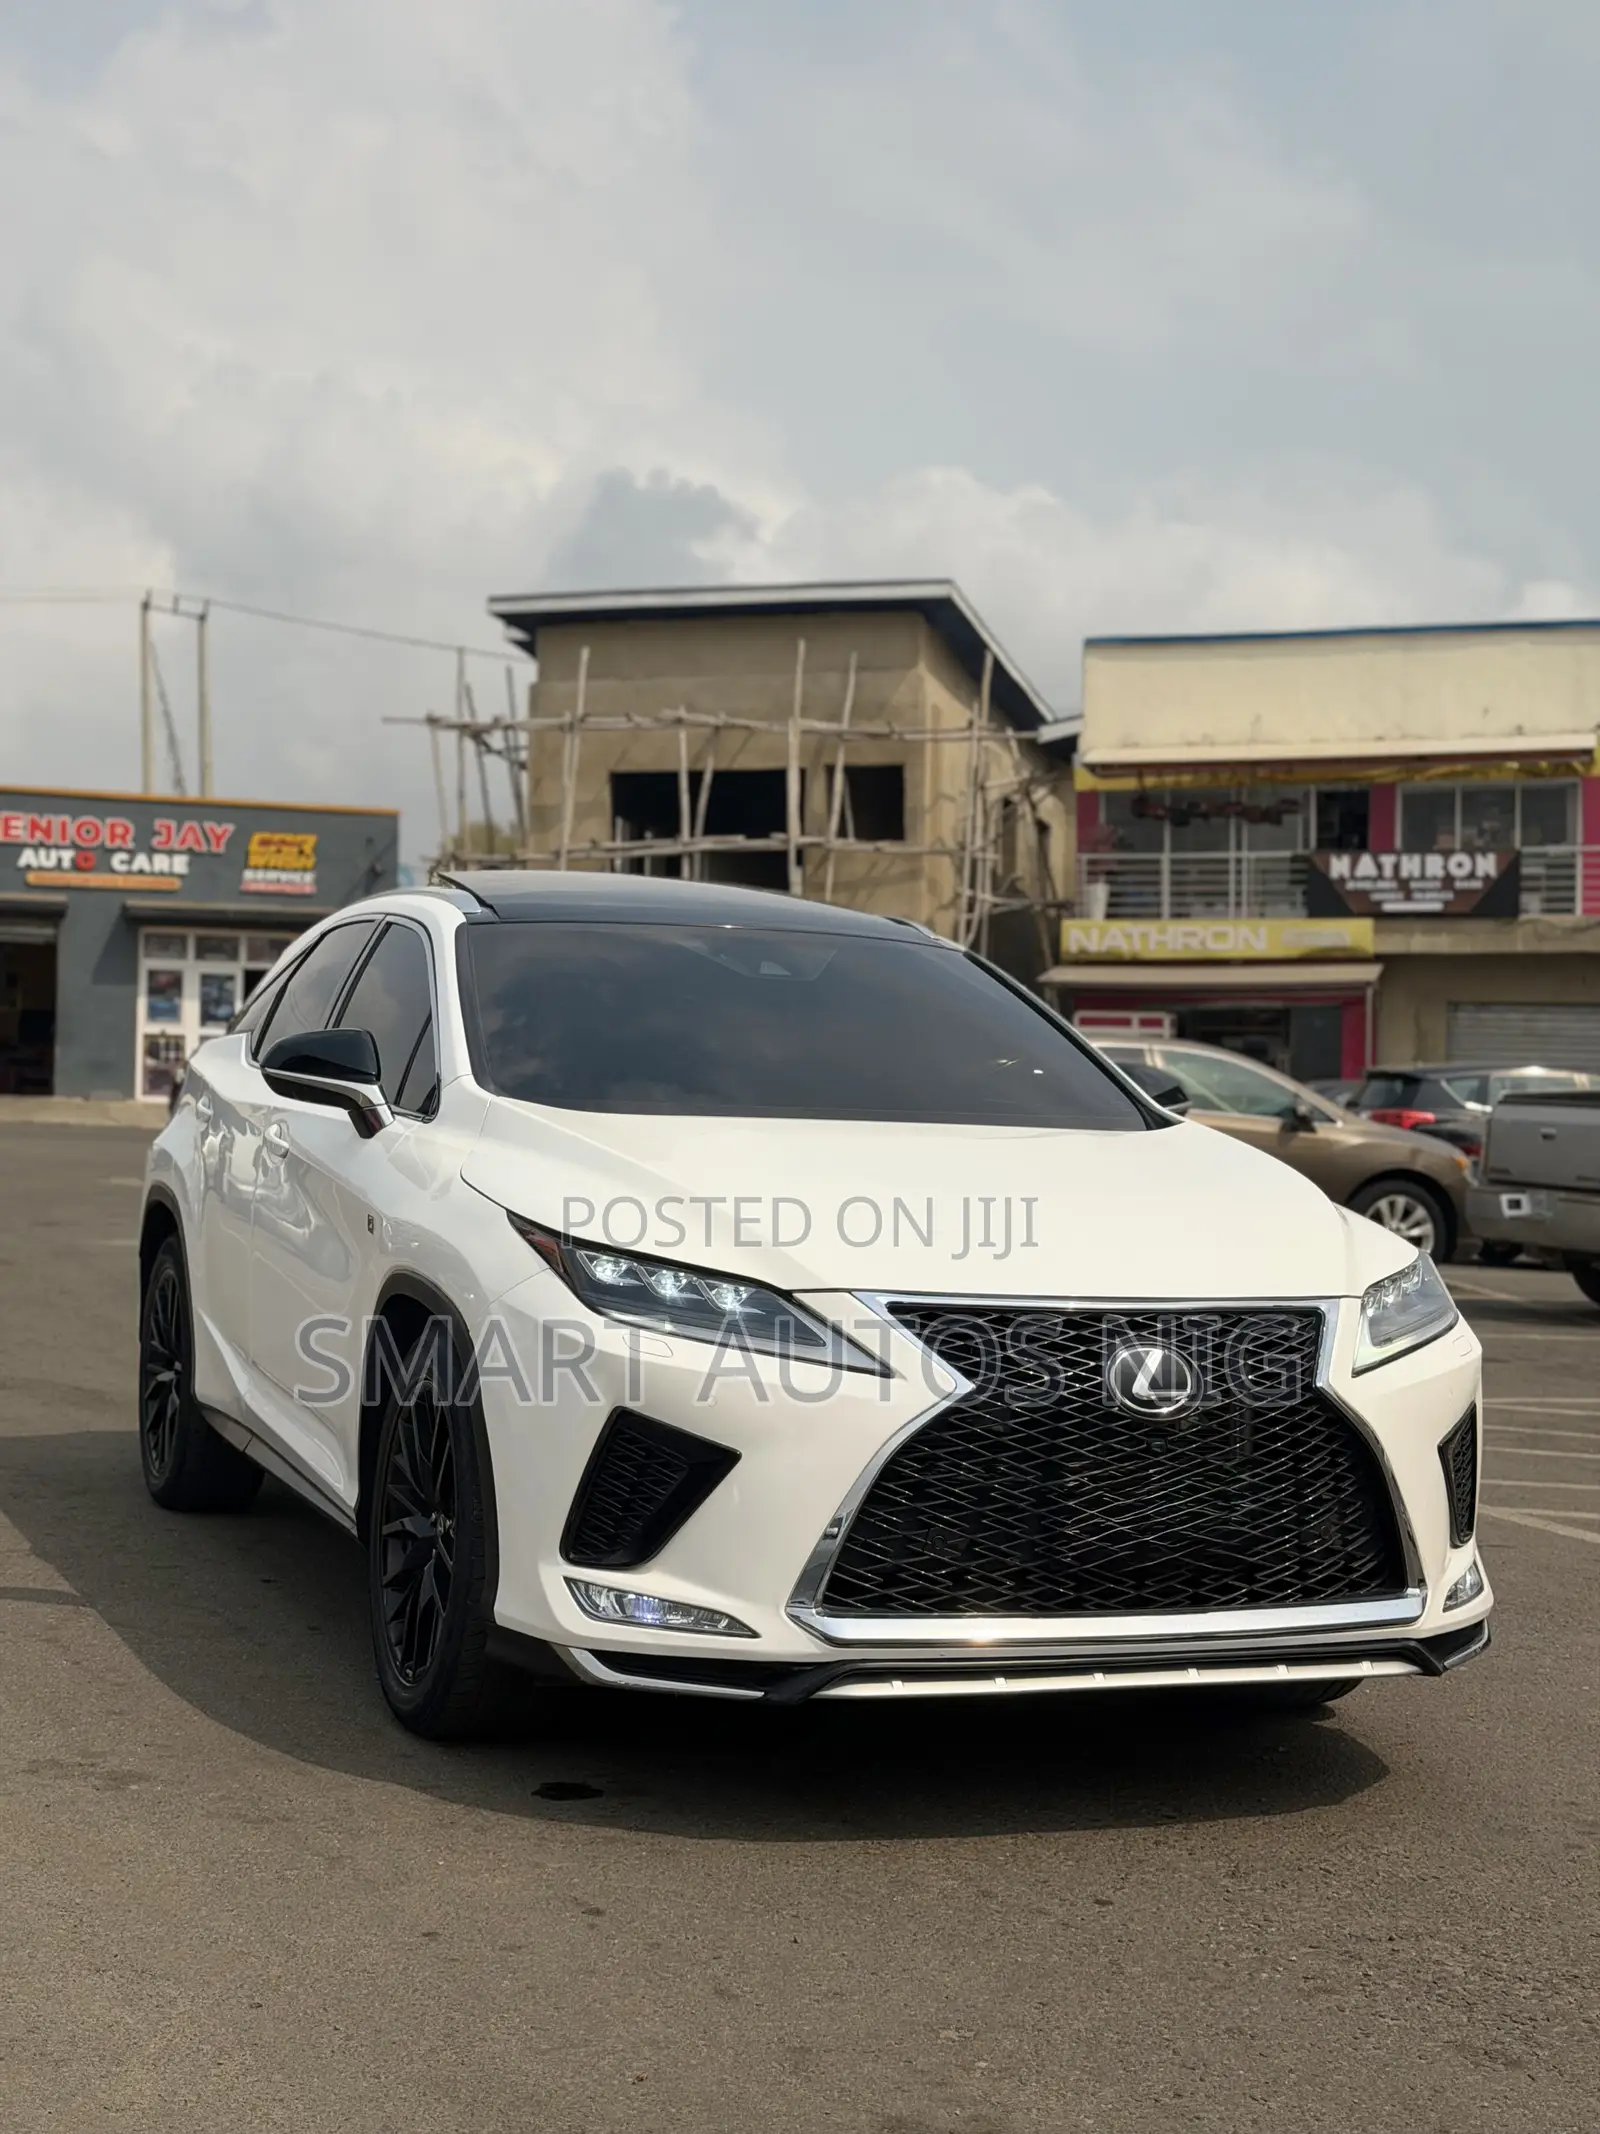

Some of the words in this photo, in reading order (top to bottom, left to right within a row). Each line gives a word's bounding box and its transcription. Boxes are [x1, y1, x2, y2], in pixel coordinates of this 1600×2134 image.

[151, 817, 236, 854] JAY
[17, 848, 97, 871] AUTO
[110, 850, 191, 876] CARE
[1329, 852, 1498, 880] NATHRON
[1067, 925, 1268, 953] NATHRON
